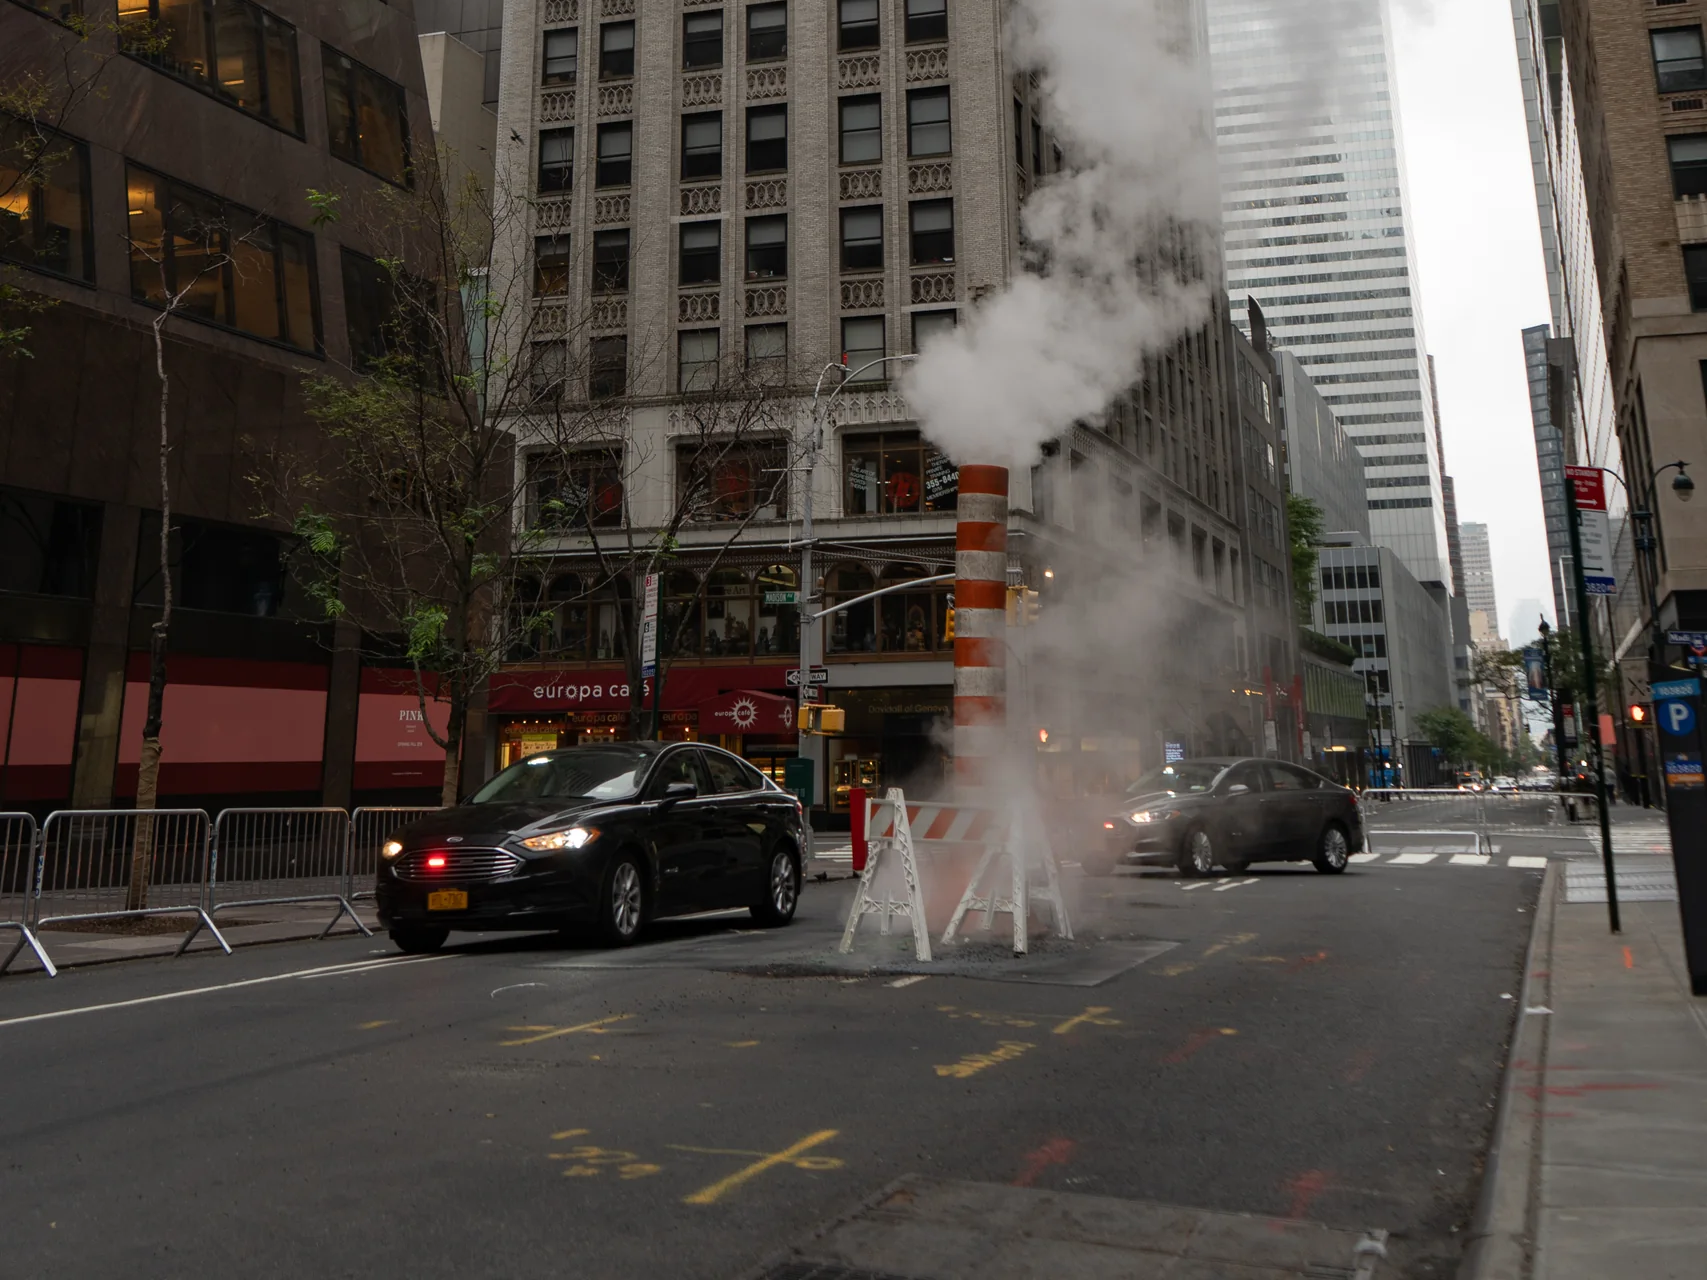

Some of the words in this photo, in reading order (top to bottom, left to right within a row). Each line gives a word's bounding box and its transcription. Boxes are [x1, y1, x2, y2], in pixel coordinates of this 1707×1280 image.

[1566, 468, 1574, 476] NO
[1575, 469, 1599, 478] STANDING
[765, 593, 786, 602] MADISON
[533, 684, 602, 702] europa
[609, 680, 650, 698] caé
[904, 704, 913, 713] of
[914, 704, 949, 713] Geneva
[399, 709, 424, 721] PINK
[1668, 703, 1689, 731] P
[34, 856, 44, 897] NYPD
